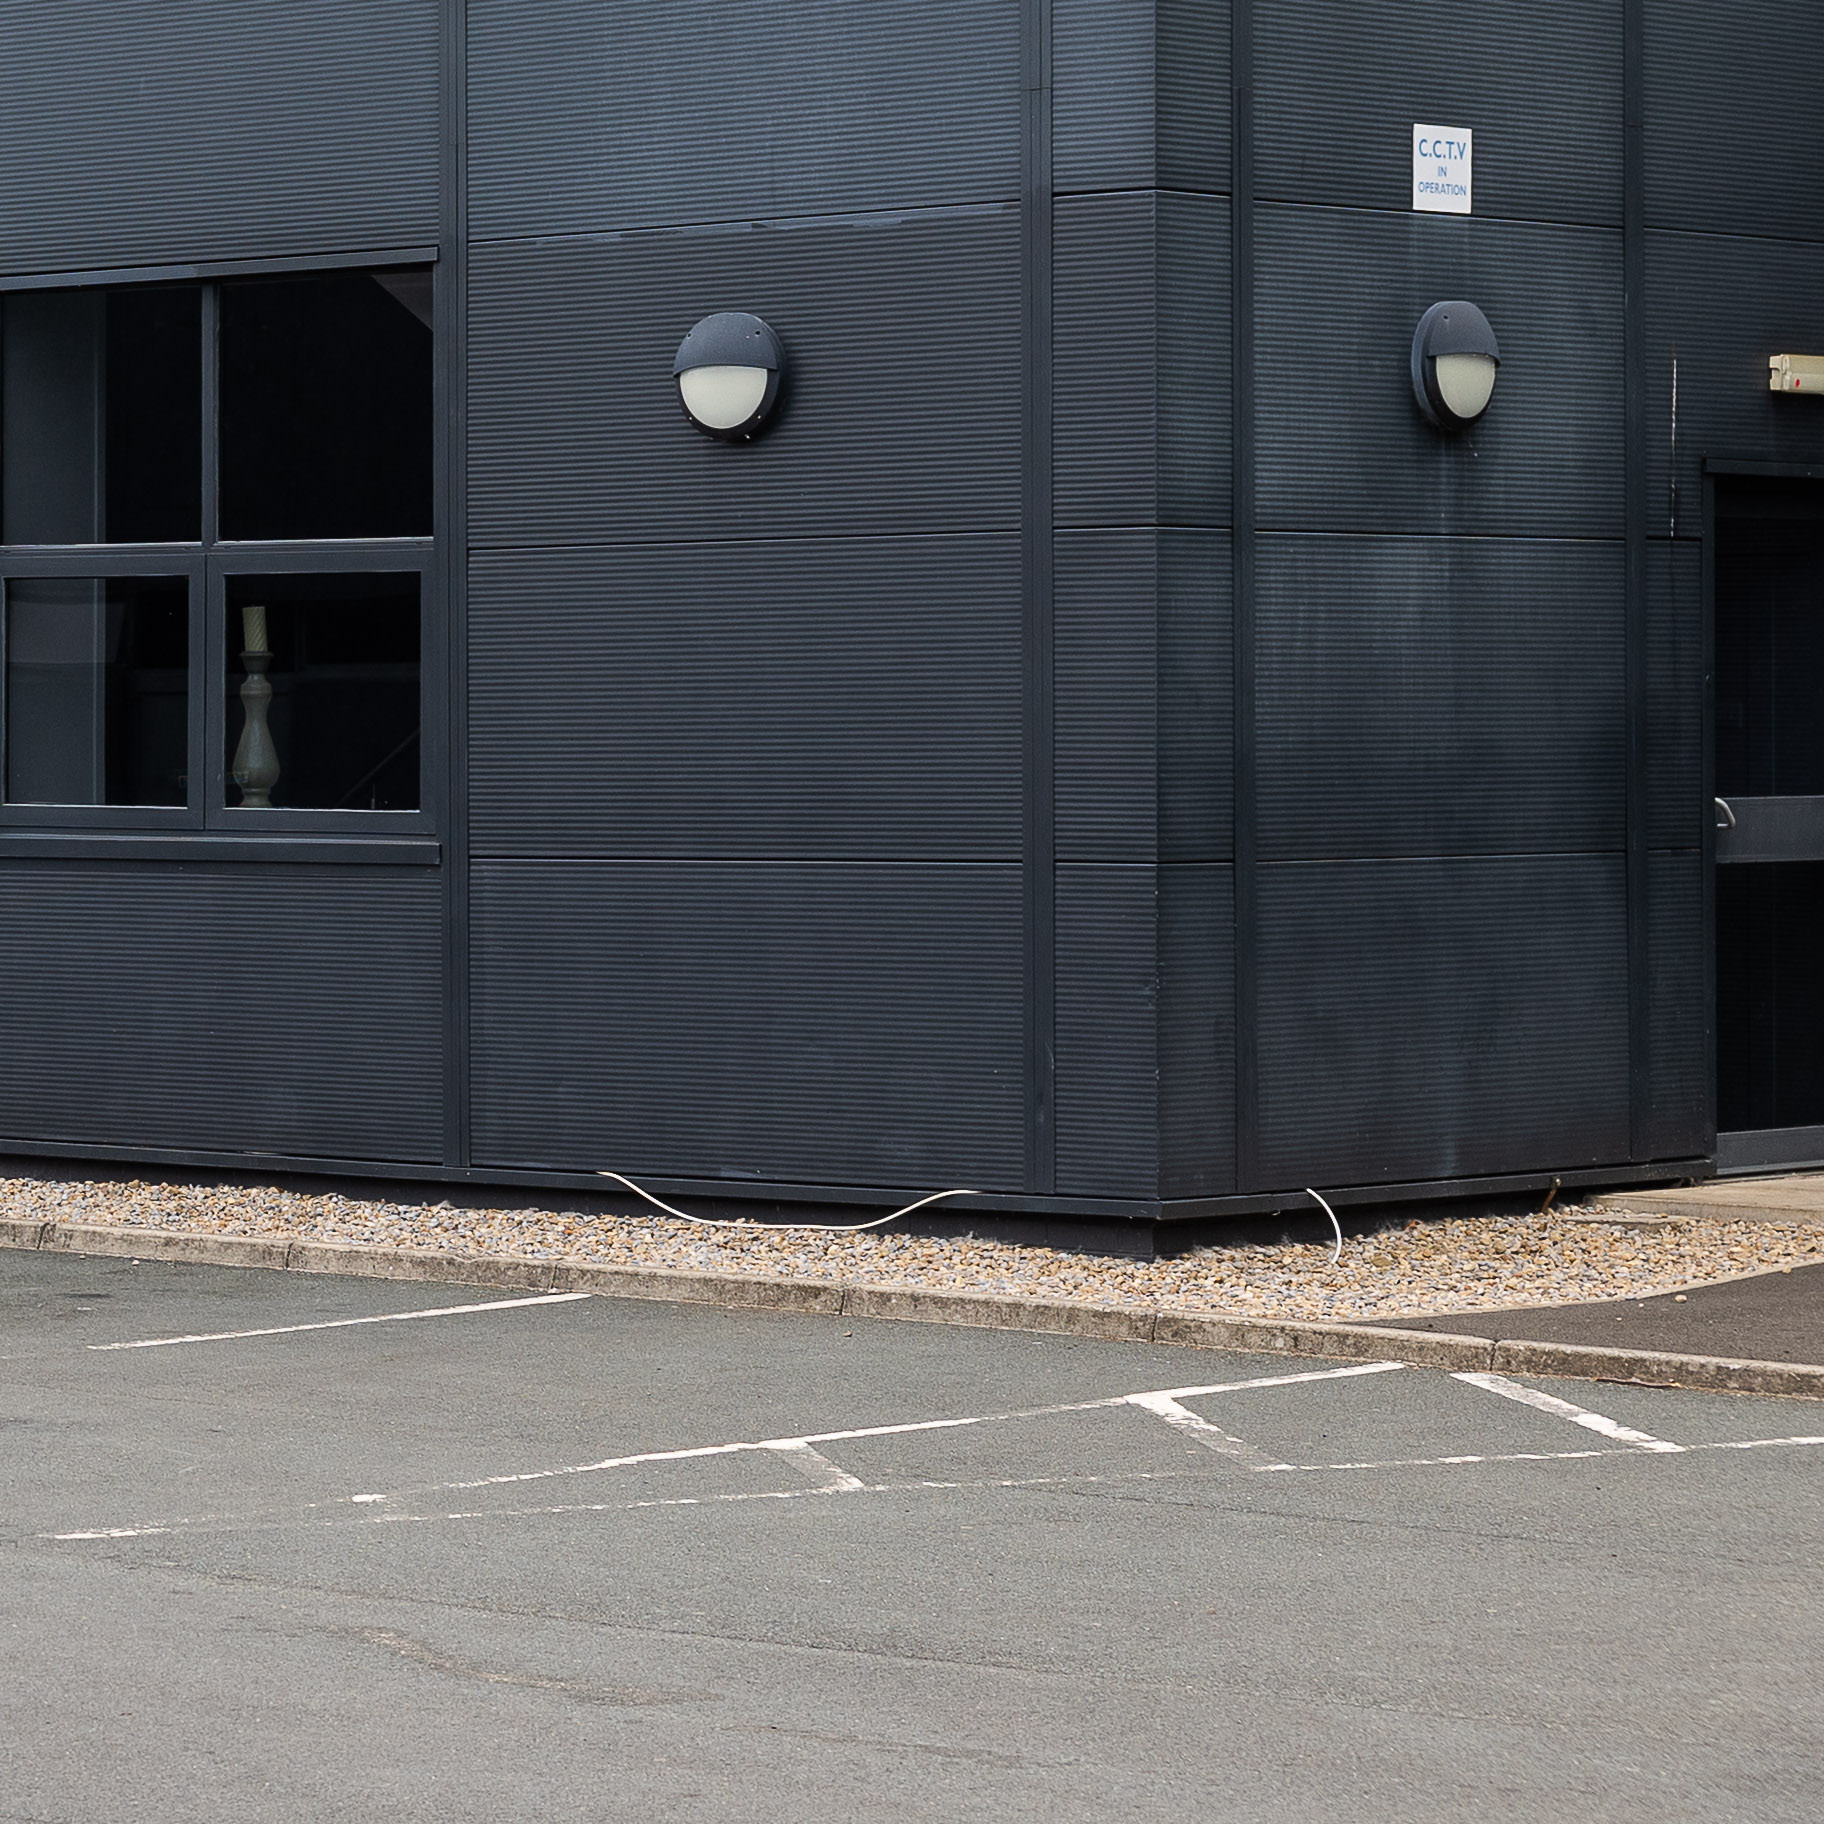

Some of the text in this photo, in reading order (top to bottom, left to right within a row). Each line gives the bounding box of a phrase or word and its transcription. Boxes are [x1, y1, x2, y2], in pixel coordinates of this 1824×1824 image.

[1418, 138, 1467, 161] C.C.T.V
[1437, 166, 1447, 177] IN
[1418, 181, 1467, 196] OPERATION
